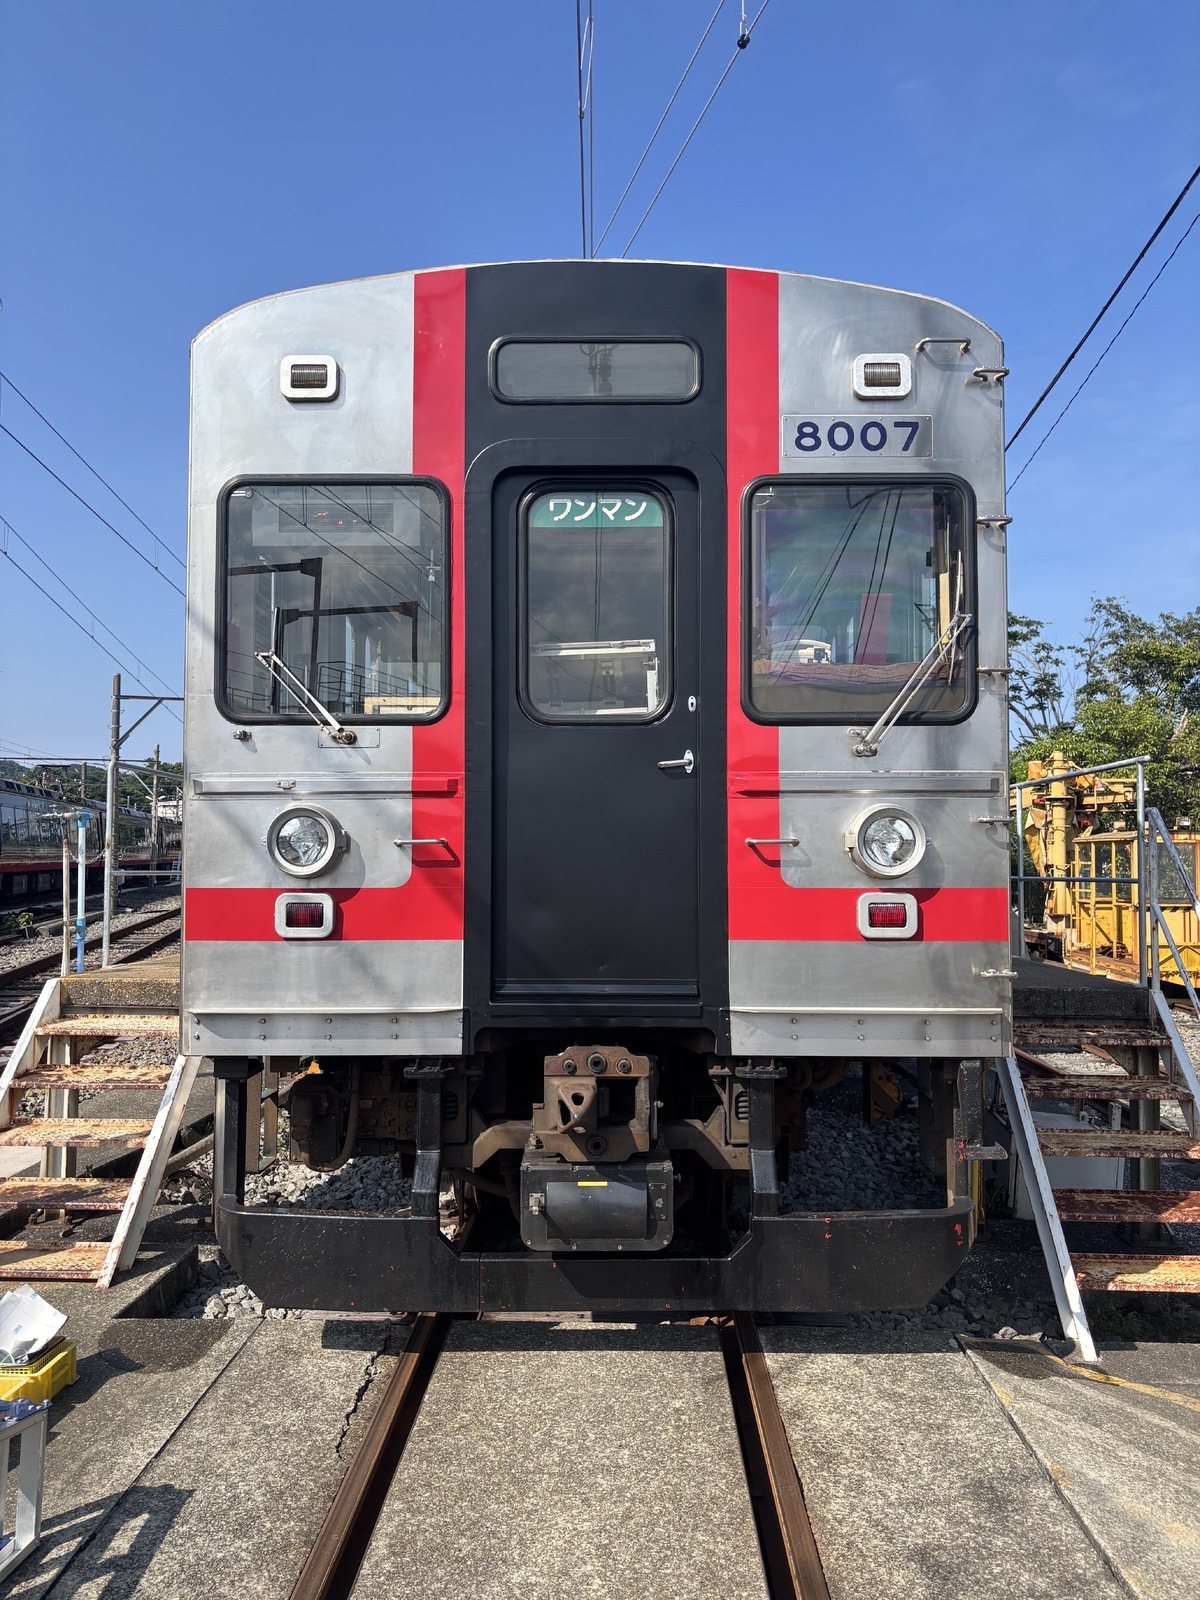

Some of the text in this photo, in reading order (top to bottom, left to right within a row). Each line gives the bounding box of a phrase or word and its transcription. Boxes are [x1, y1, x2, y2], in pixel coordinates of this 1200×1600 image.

[795, 421, 919, 452] 8007
[549, 499, 647, 521] ワンマン
